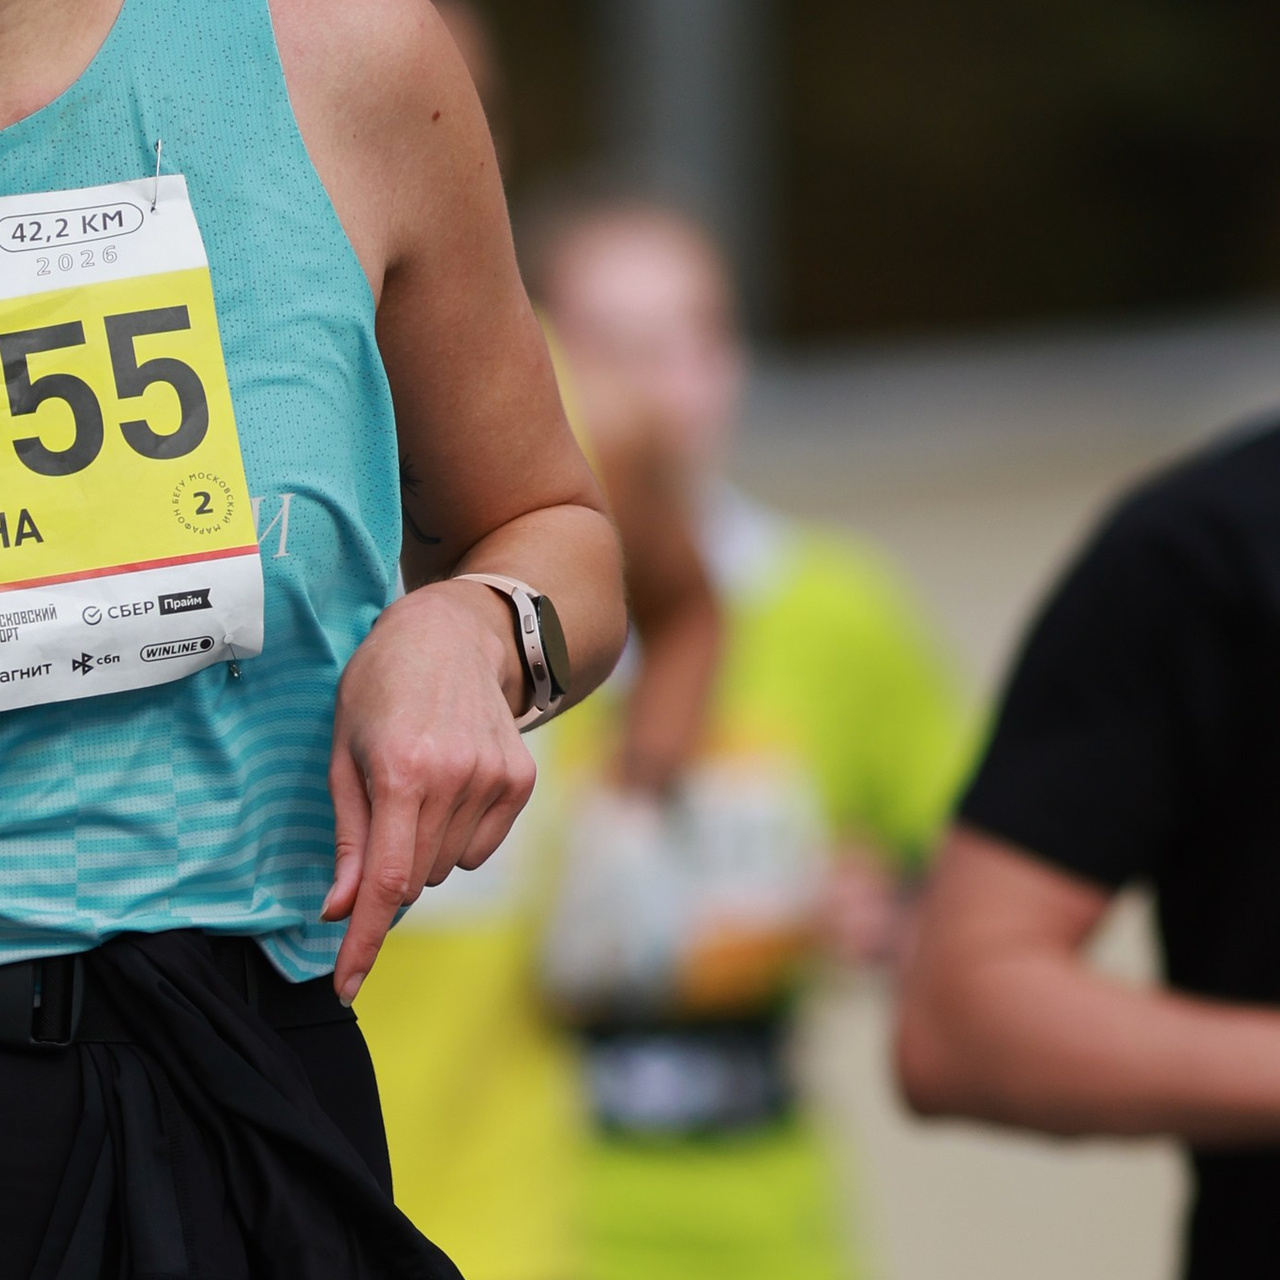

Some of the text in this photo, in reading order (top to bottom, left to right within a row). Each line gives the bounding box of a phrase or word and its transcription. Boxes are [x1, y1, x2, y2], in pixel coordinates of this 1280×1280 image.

[10, 210, 124, 243] 42,2 КМ
[35, 245, 118, 276] 2026
[171, 479, 186, 505] БЕГУ
[188, 471, 235, 524] МОСКОВСКИЙ
[192, 490, 214, 516] 2
[172, 508, 222, 535] МАРАФОН
[107, 600, 155, 620] СБЕР
[163, 595, 203, 611] Прайм
[96, 653, 121, 666] сбп
[146, 640, 199, 659] WINLINE
